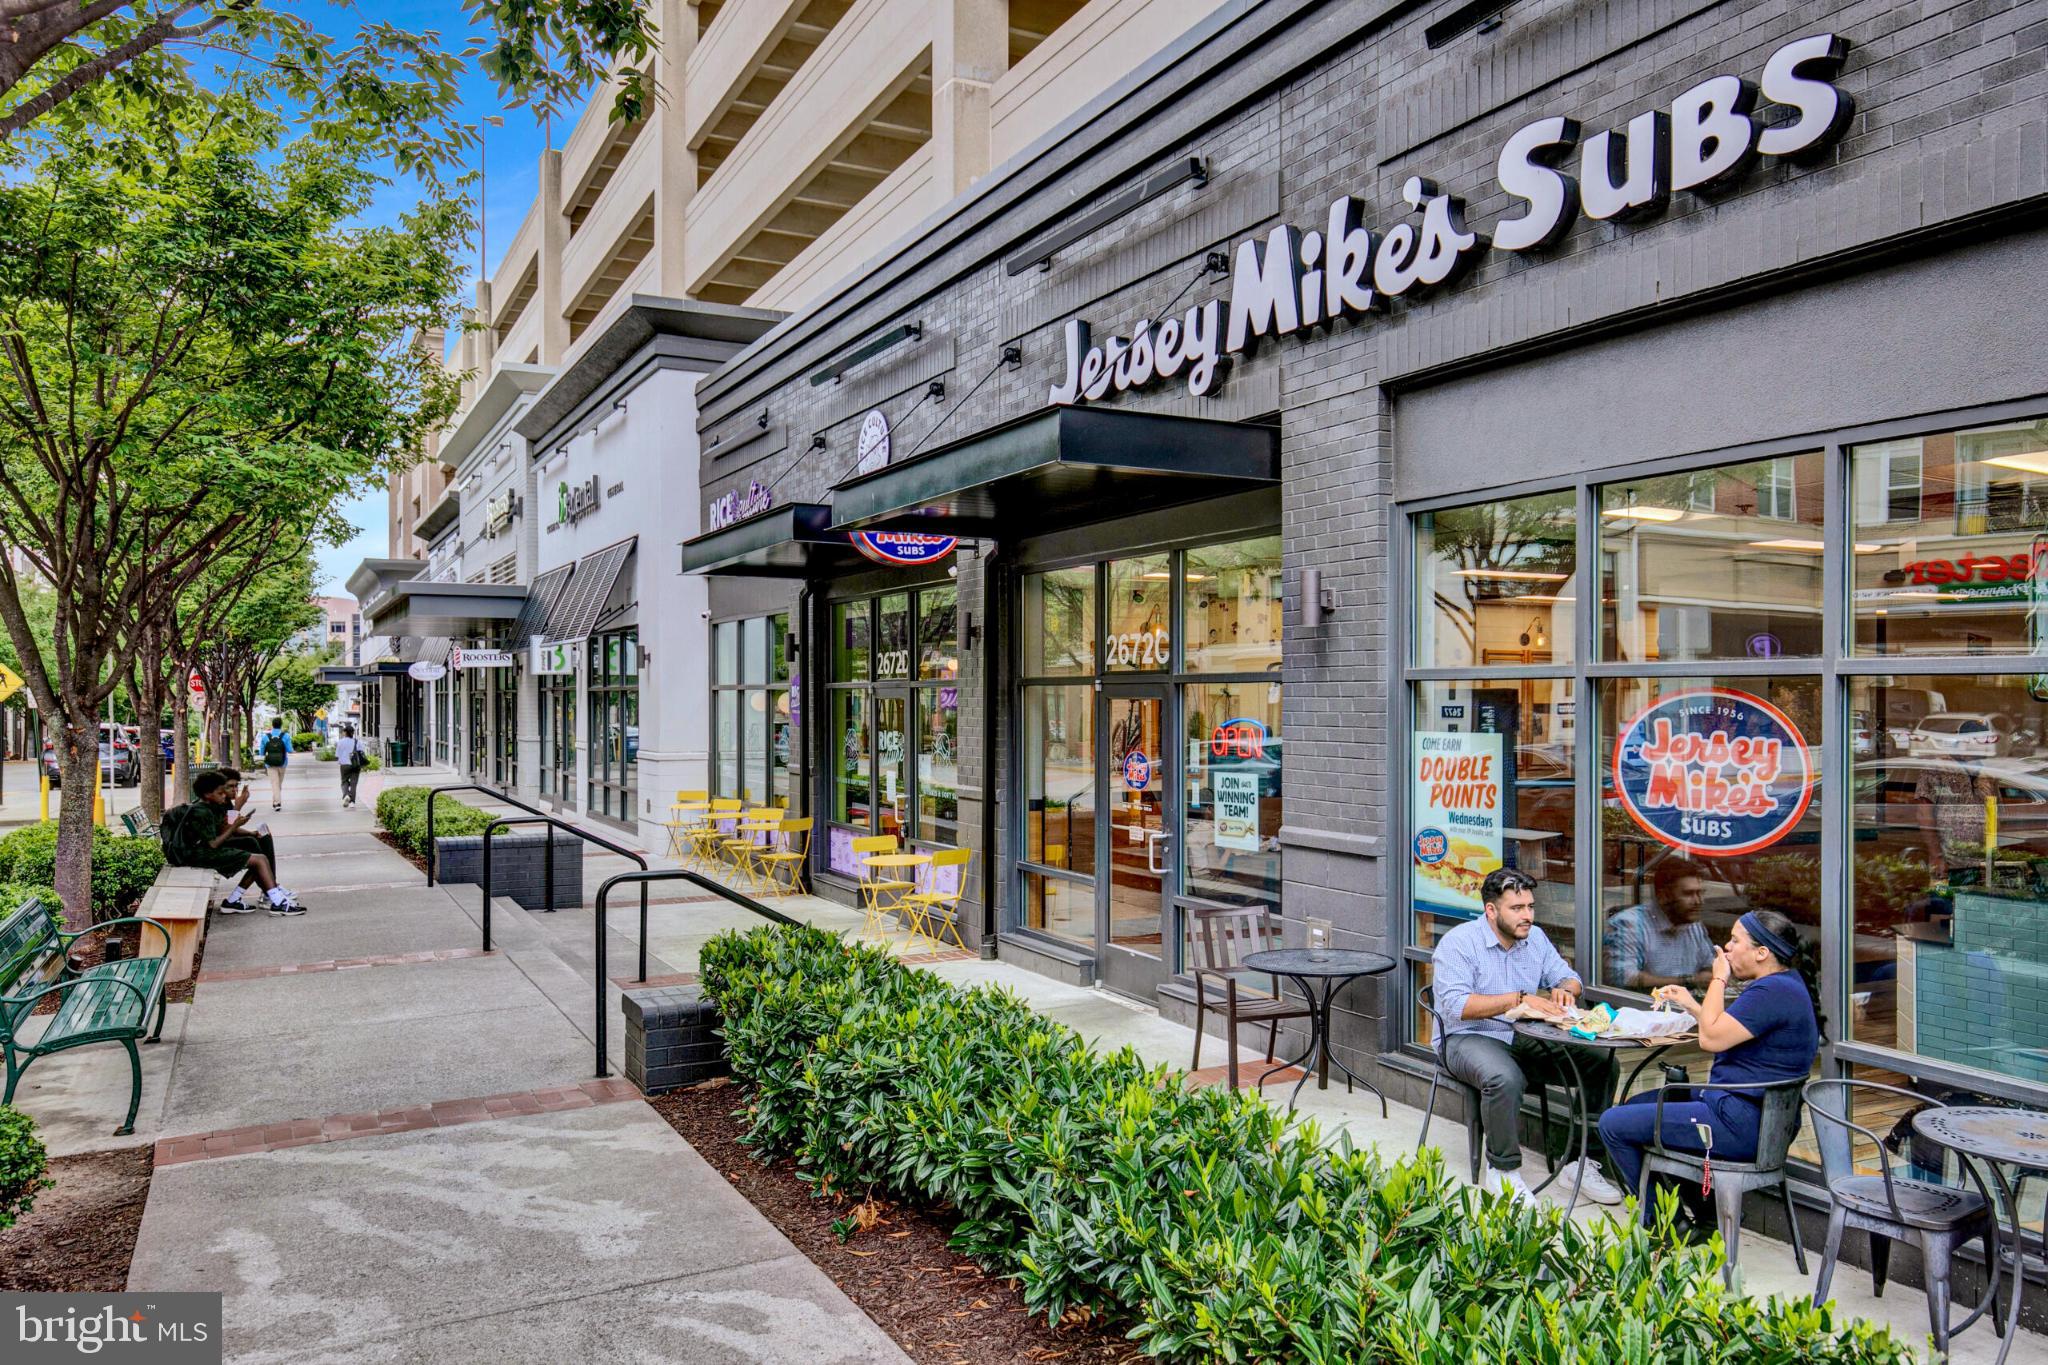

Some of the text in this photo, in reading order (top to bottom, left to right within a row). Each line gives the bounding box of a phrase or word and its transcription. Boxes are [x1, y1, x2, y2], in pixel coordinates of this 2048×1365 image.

[1050, 33, 1856, 404] Jersey Mike's SUBS
[710, 491, 733, 532] RICE
[897, 545, 925, 556] SUBS
[462, 652, 511, 662] ROOSTERS
[1105, 631, 1170, 665] 2672C
[877, 649, 909, 675] 2672D
[1678, 705, 1745, 722] SINCE 1956
[878, 729, 899, 751] RICE
[1211, 725, 1263, 759] OPEN
[1422, 737, 1462, 751] COME EARN
[1639, 717, 1783, 786] Jersey
[1420, 755, 1492, 783] DOUBLE
[1221, 777, 1240, 789] JOIN
[1646, 762, 1779, 818] Mike's
[1217, 790, 1256, 805] WINNING
[1429, 783, 1498, 810] POINTS
[1223, 804, 1249, 819] TEAM!
[1448, 811, 1493, 829] Wednesdays
[1680, 817, 1733, 839] SUBS
